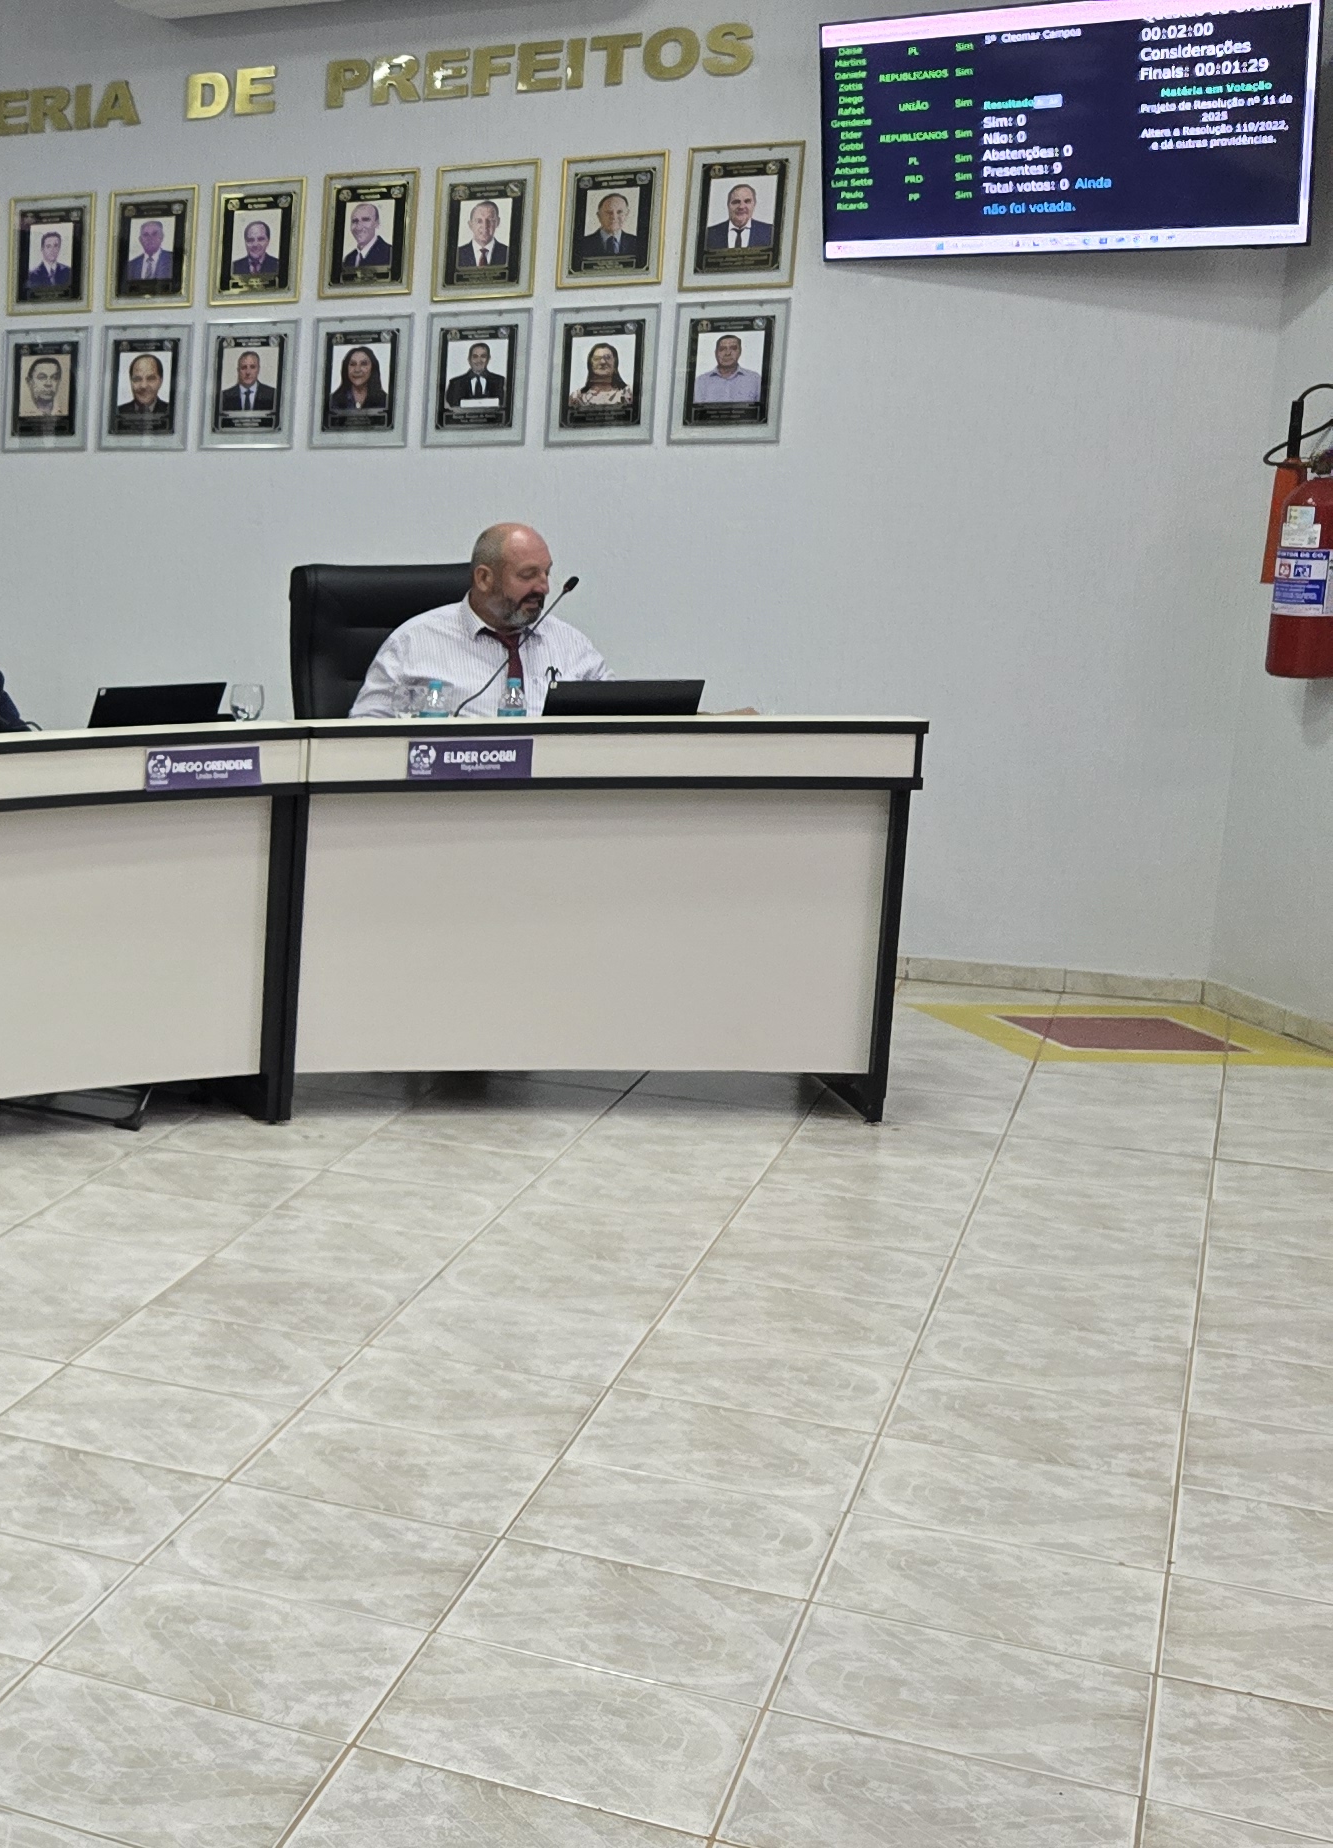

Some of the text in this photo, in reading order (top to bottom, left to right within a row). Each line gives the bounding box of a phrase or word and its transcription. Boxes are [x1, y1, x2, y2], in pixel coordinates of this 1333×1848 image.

[1141, 22, 1214, 41] 00:02:00
[1140, 39, 1252, 62] Considerações
[186, 65, 276, 121] DE
[324, 22, 754, 110] PREFEITOS
[1139, 57, 1269, 81] Finais: 00:01:29
[1016, 114, 1027, 127] 0
[1016, 130, 1027, 143] 0
[1062, 144, 1073, 157] 0
[983, 181, 1013, 194] Total
[1059, 178, 1070, 191] 0
[1074, 176, 1112, 189] Ainda
[983, 200, 1076, 215] não foi votada.
[443, 749, 517, 764] ELDER GOBBI
[172, 759, 253, 774] DIEGO GRENDENE
